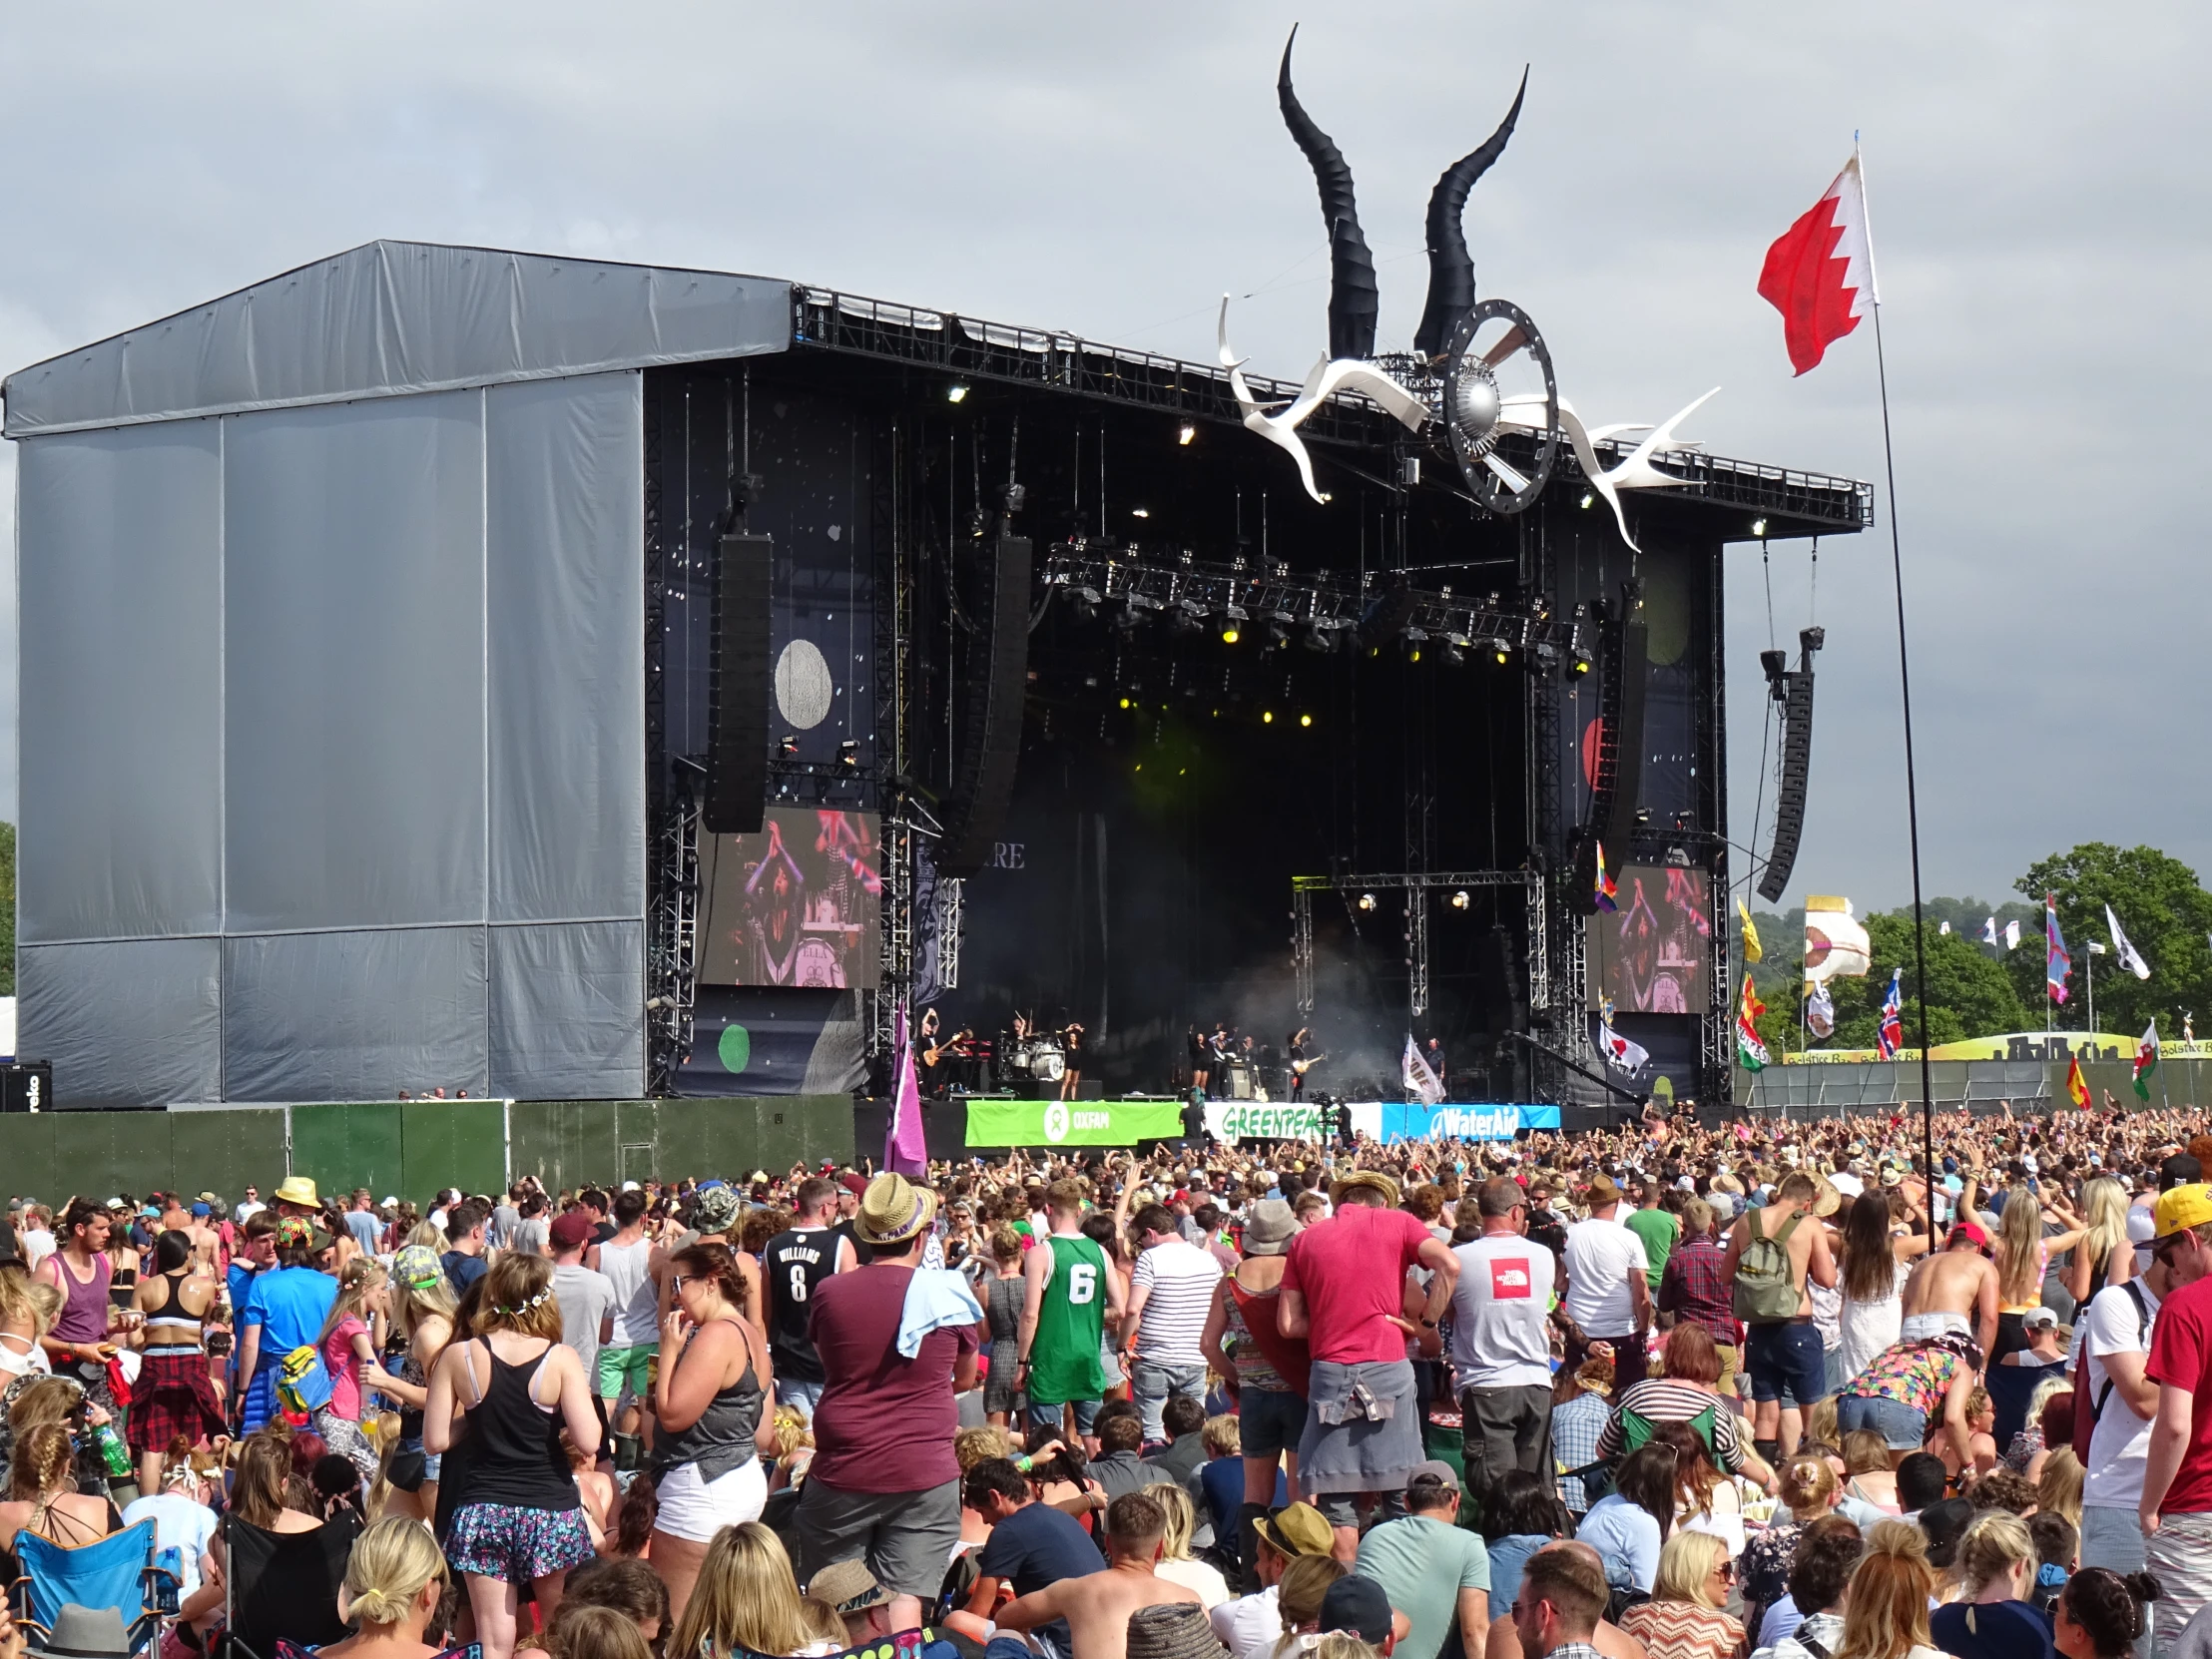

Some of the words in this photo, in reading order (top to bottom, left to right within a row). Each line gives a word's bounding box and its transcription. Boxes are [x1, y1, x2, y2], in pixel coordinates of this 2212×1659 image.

[983, 841, 1025, 869] RE
[803, 947, 828, 959] ELLA
[1073, 1111, 1110, 1130] OXFAM
[1442, 1107, 1519, 1137] WaterAid
[778, 1246, 822, 1265] WILLIAMS
[790, 1264, 808, 1303] 8
[1068, 1263, 1097, 1305] 6
